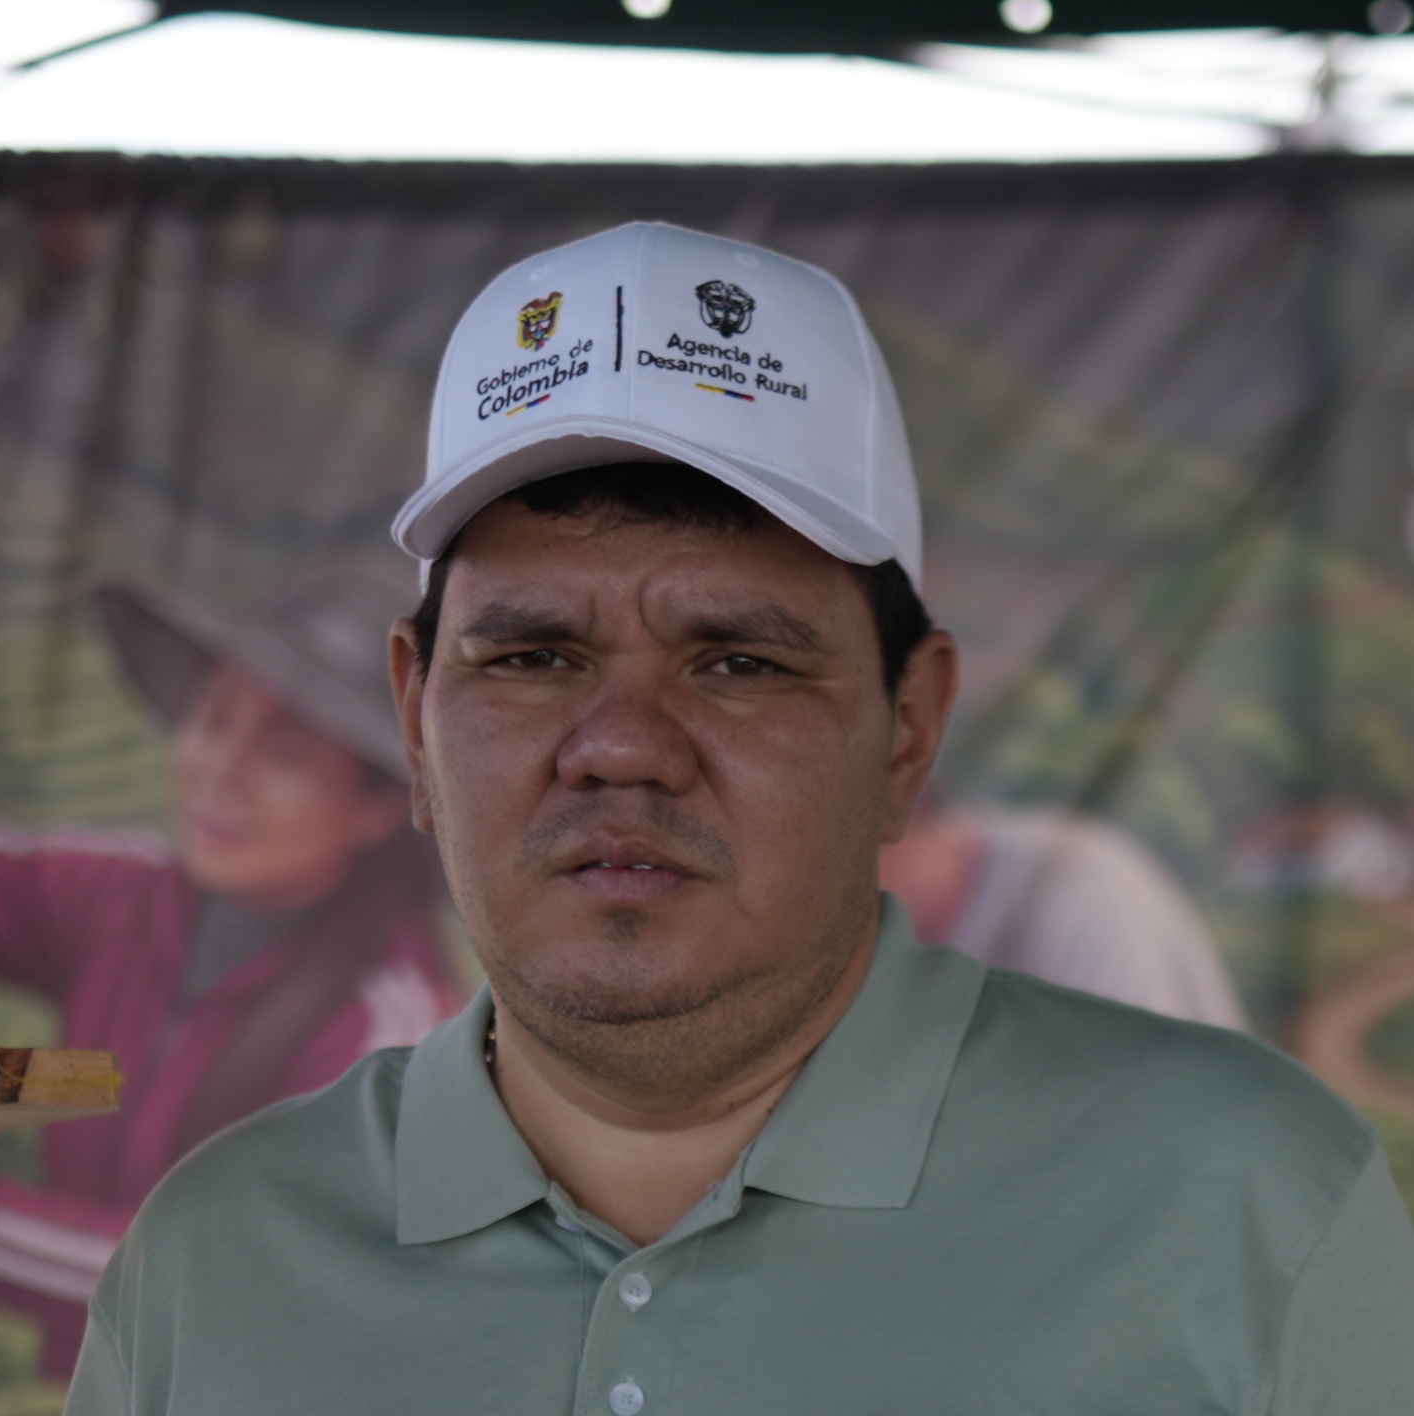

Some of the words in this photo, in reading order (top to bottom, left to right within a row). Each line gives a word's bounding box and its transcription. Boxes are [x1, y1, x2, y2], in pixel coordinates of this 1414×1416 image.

[476, 354, 560, 395] Gobierno
[568, 337, 593, 358] de
[637, 349, 747, 385] Desarrollo
[754, 372, 808, 402] Rural
[666, 332, 752, 367] Agencia
[757, 351, 784, 374] de
[477, 359, 588, 421] Colombia
